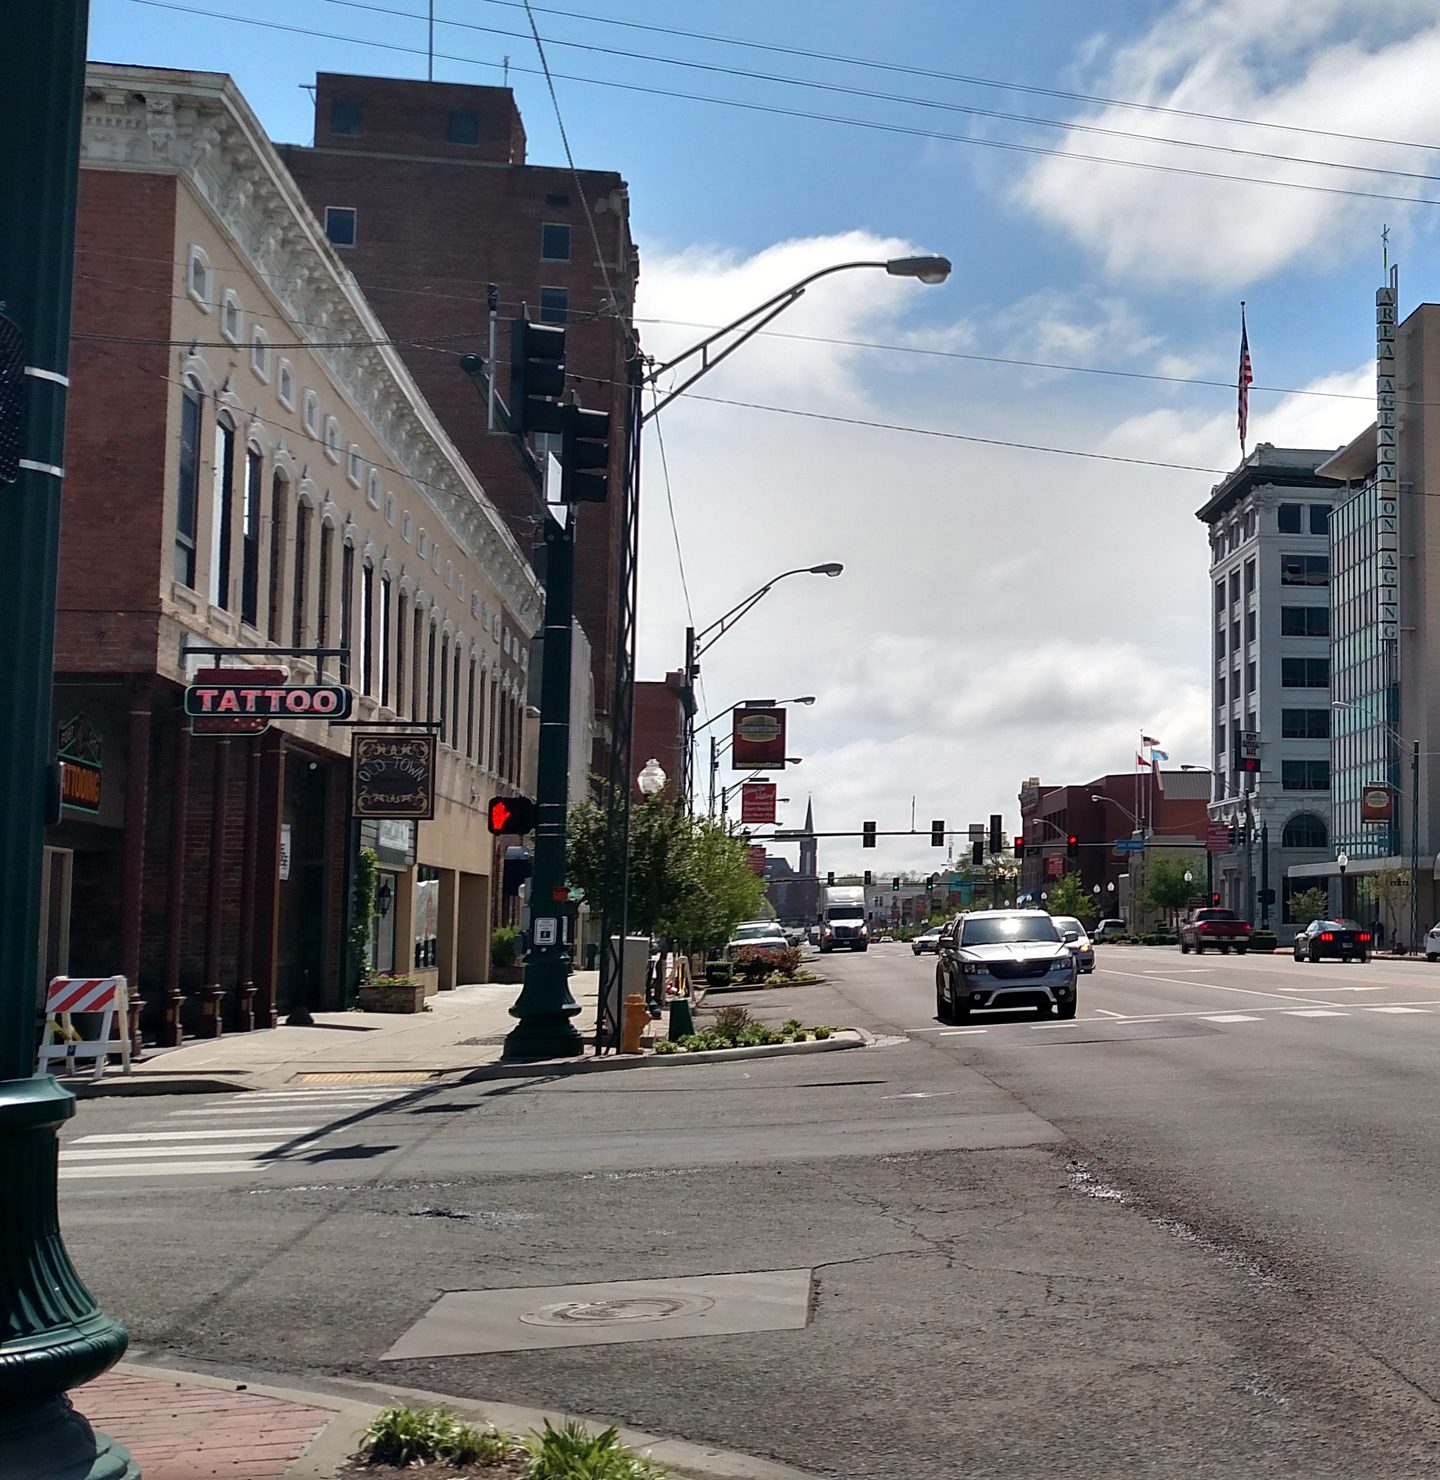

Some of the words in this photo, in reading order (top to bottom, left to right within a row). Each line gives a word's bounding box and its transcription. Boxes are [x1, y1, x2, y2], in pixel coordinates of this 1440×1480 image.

[1383, 290, 1393, 356] AREA
[1382, 379, 1394, 478] AGENCY
[1384, 502, 1395, 530] ON
[1384, 554, 1395, 638] AGING
[196, 689, 338, 712] TATTOO
[358, 759, 387, 782] OLD
[393, 756, 429, 782] TOWN
